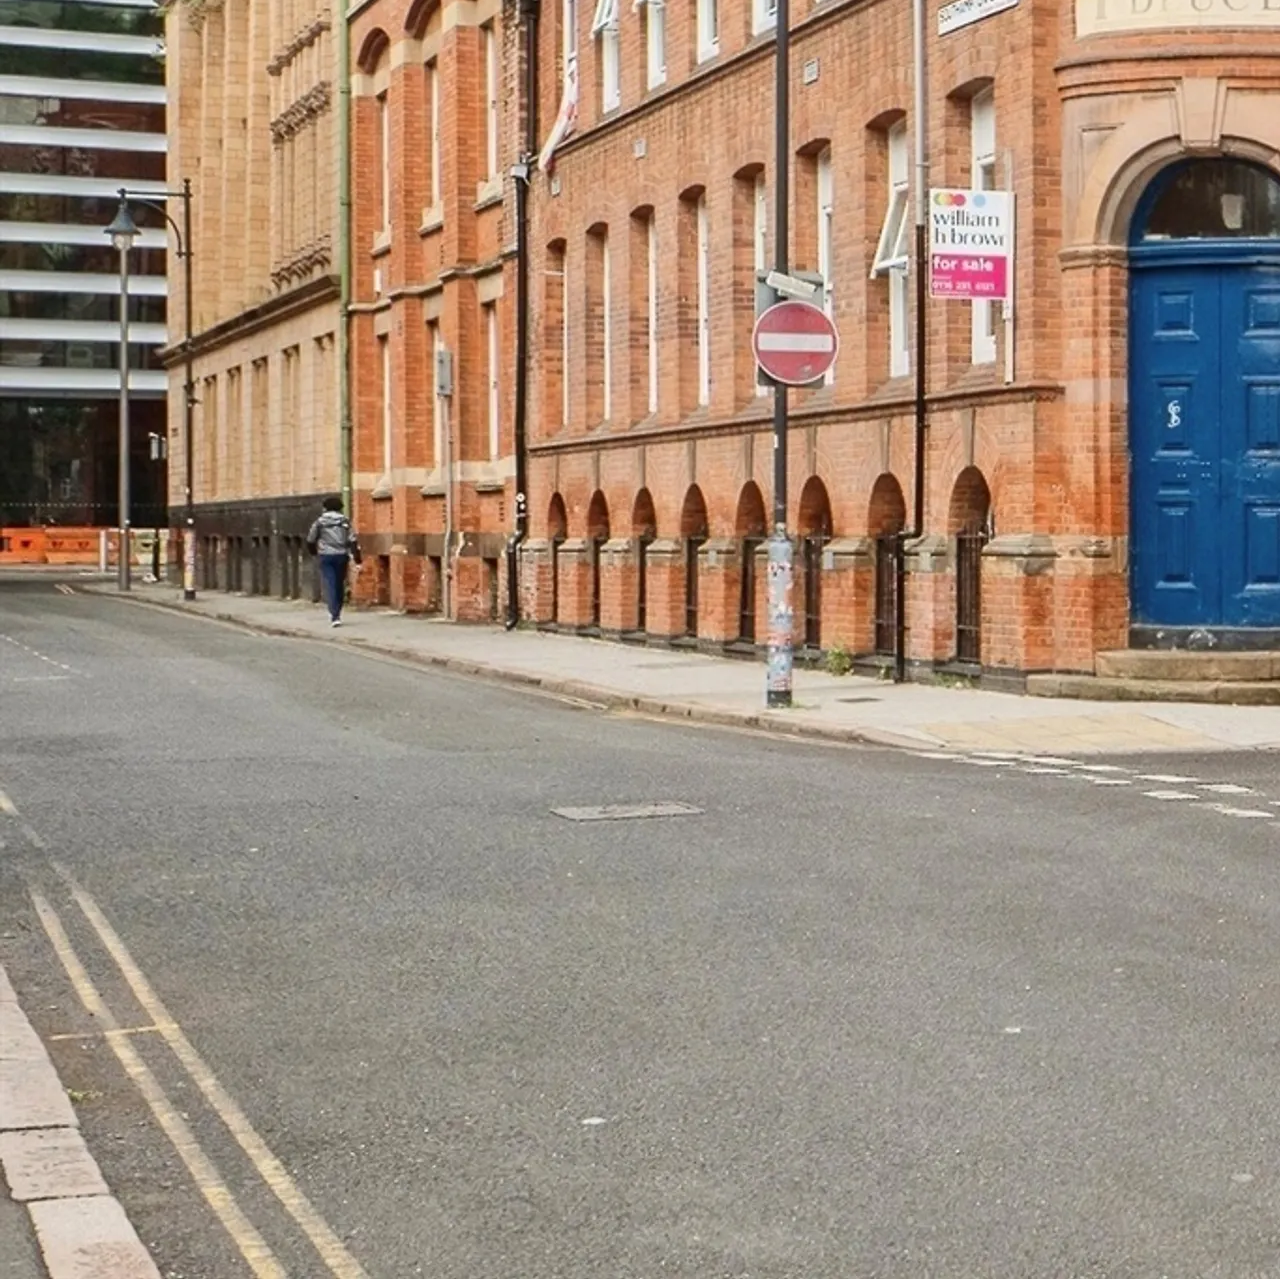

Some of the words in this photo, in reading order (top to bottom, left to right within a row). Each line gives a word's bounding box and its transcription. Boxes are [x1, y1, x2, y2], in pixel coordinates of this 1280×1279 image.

[933, 209, 999, 227] william
[935, 227, 946, 244] h
[934, 256, 958, 271] for
[961, 257, 994, 272] sale
